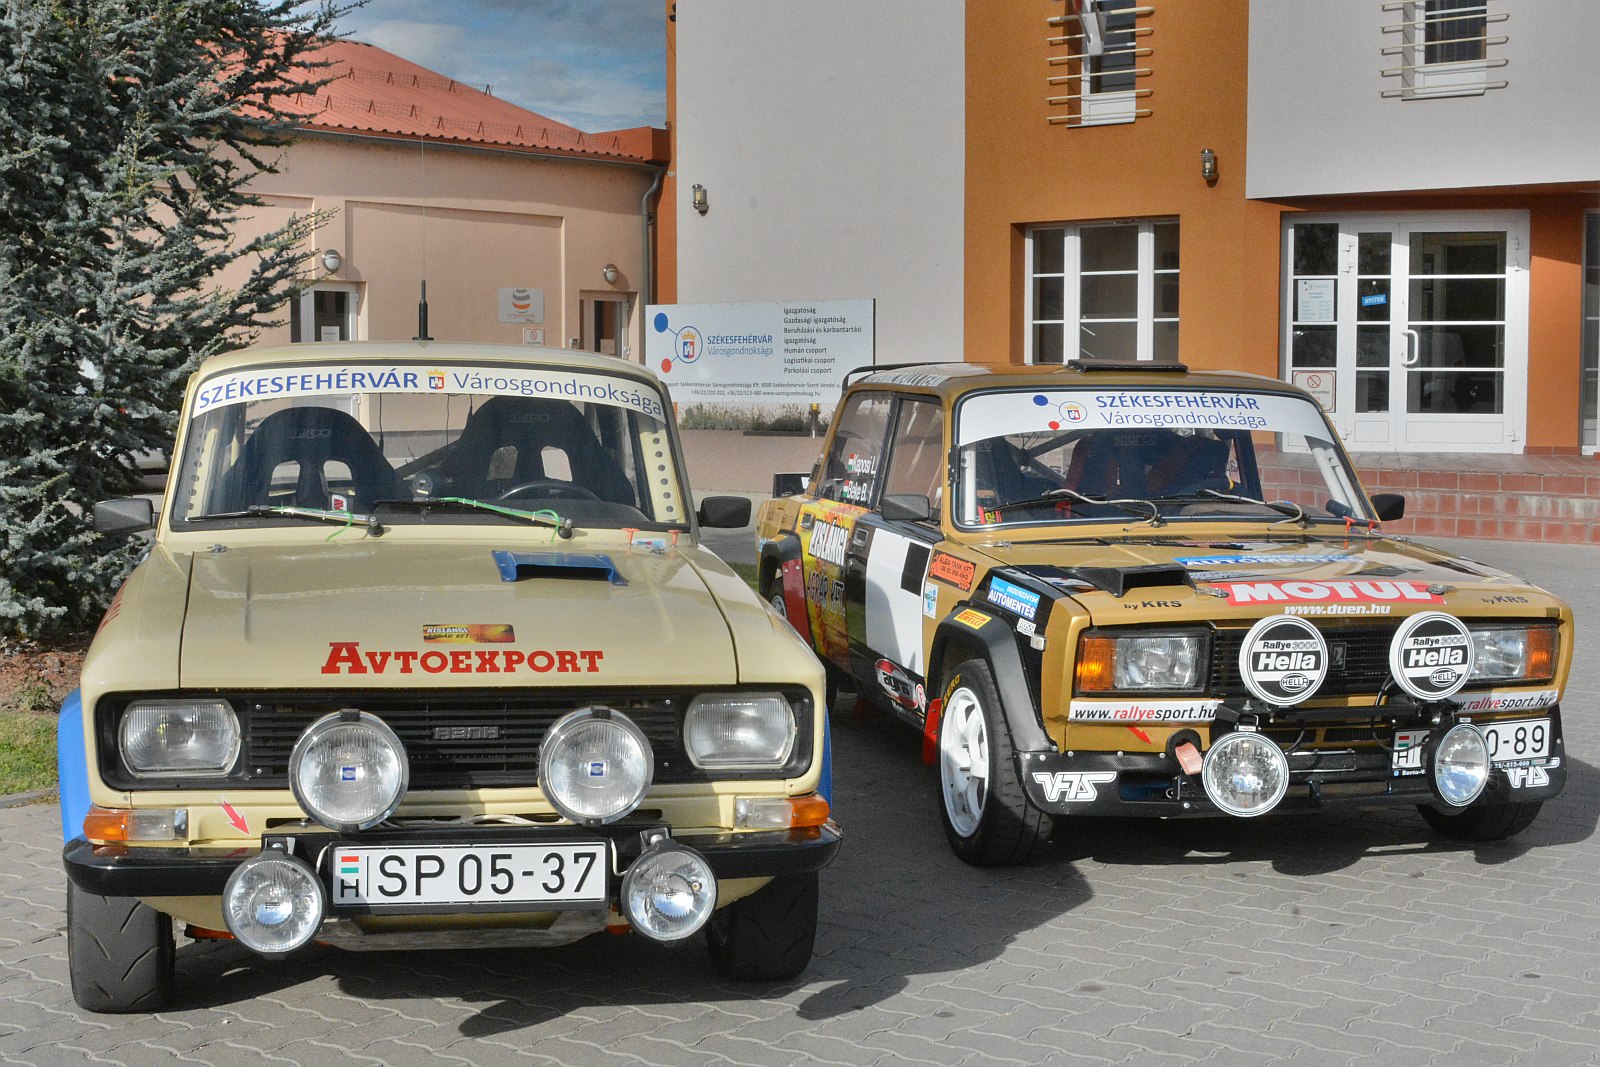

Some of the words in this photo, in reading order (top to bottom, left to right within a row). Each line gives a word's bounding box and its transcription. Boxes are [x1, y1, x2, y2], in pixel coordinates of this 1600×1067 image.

[783, 306, 816, 314] Igazgatóság
[783, 317, 812, 325] Gazdasági
[813, 316, 846, 324] igazgatóság
[823, 325, 862, 333] karbantartási
[707, 333, 773, 345] SZÉKESFEHÉRVÁR
[783, 337, 816, 345] igazgatóság
[707, 346, 774, 357] Városgondnoksága
[783, 357, 813, 365] Logisztikai
[199, 368, 419, 409] SZÉKESFEHÉRVÁR
[453, 372, 662, 415] Városgondnoksága
[1095, 392, 1261, 410] SZÉKESFEHÉRVÁR
[1100, 410, 1267, 428] Városgondnoksága
[1231, 581, 1433, 602] MOTUL
[987, 589, 1036, 618] AUTÓMENTÉS
[1141, 600, 1182, 608] KRS
[1493, 595, 1529, 603] KRS
[1284, 603, 1391, 615] www.duen.hu
[1262, 641, 1292, 651] Rallye
[1292, 641, 1319, 650] 3000
[1412, 637, 1440, 647] Rallye
[1440, 636, 1466, 646] 3000
[320, 641, 604, 674] AVTOEXPORT
[1257, 652, 1316, 671] Hella
[1408, 647, 1464, 667] Hella
[1282, 677, 1309, 686] HELLA
[1432, 671, 1457, 681] HELLA
[1456, 695, 1553, 711] w.rallyesport.hu
[1074, 705, 1218, 721] www.rallyesport.hu
[1396, 750, 1409, 765] H
[340, 878, 360, 898] H
[377, 854, 446, 897] SP
[458, 851, 598, 896] 05-37
